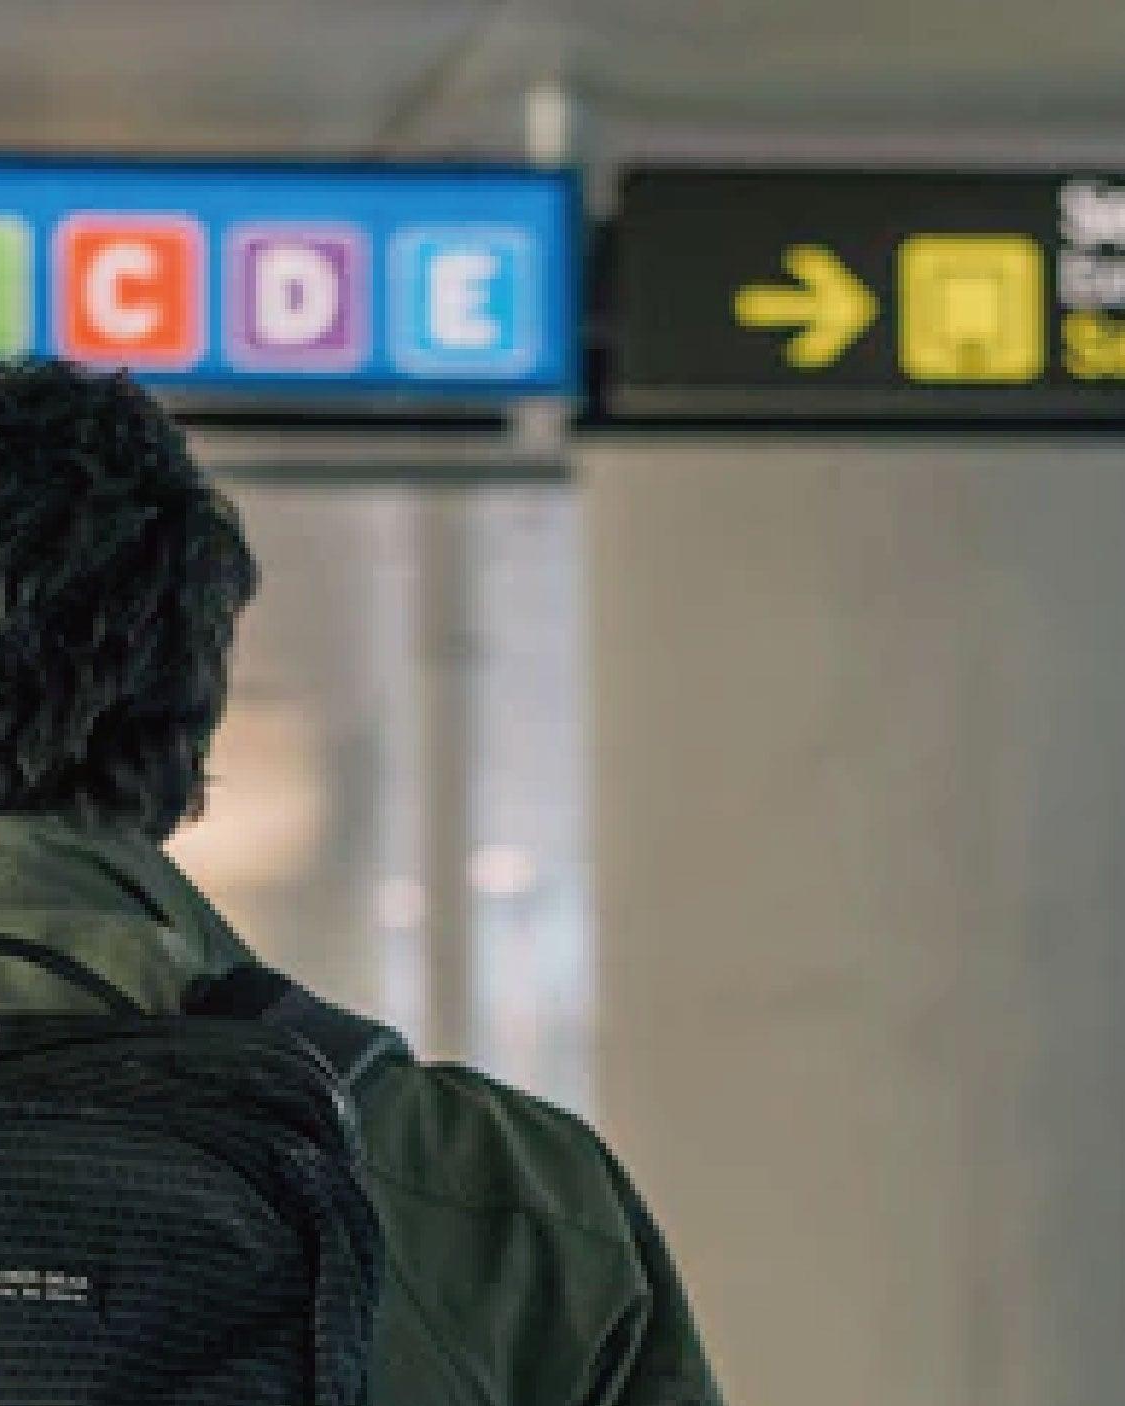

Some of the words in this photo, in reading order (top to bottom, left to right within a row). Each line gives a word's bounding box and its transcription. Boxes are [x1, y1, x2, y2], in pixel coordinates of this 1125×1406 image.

[85, 243, 159, 340] C
[255, 248, 341, 345] D
[426, 253, 502, 348] E
